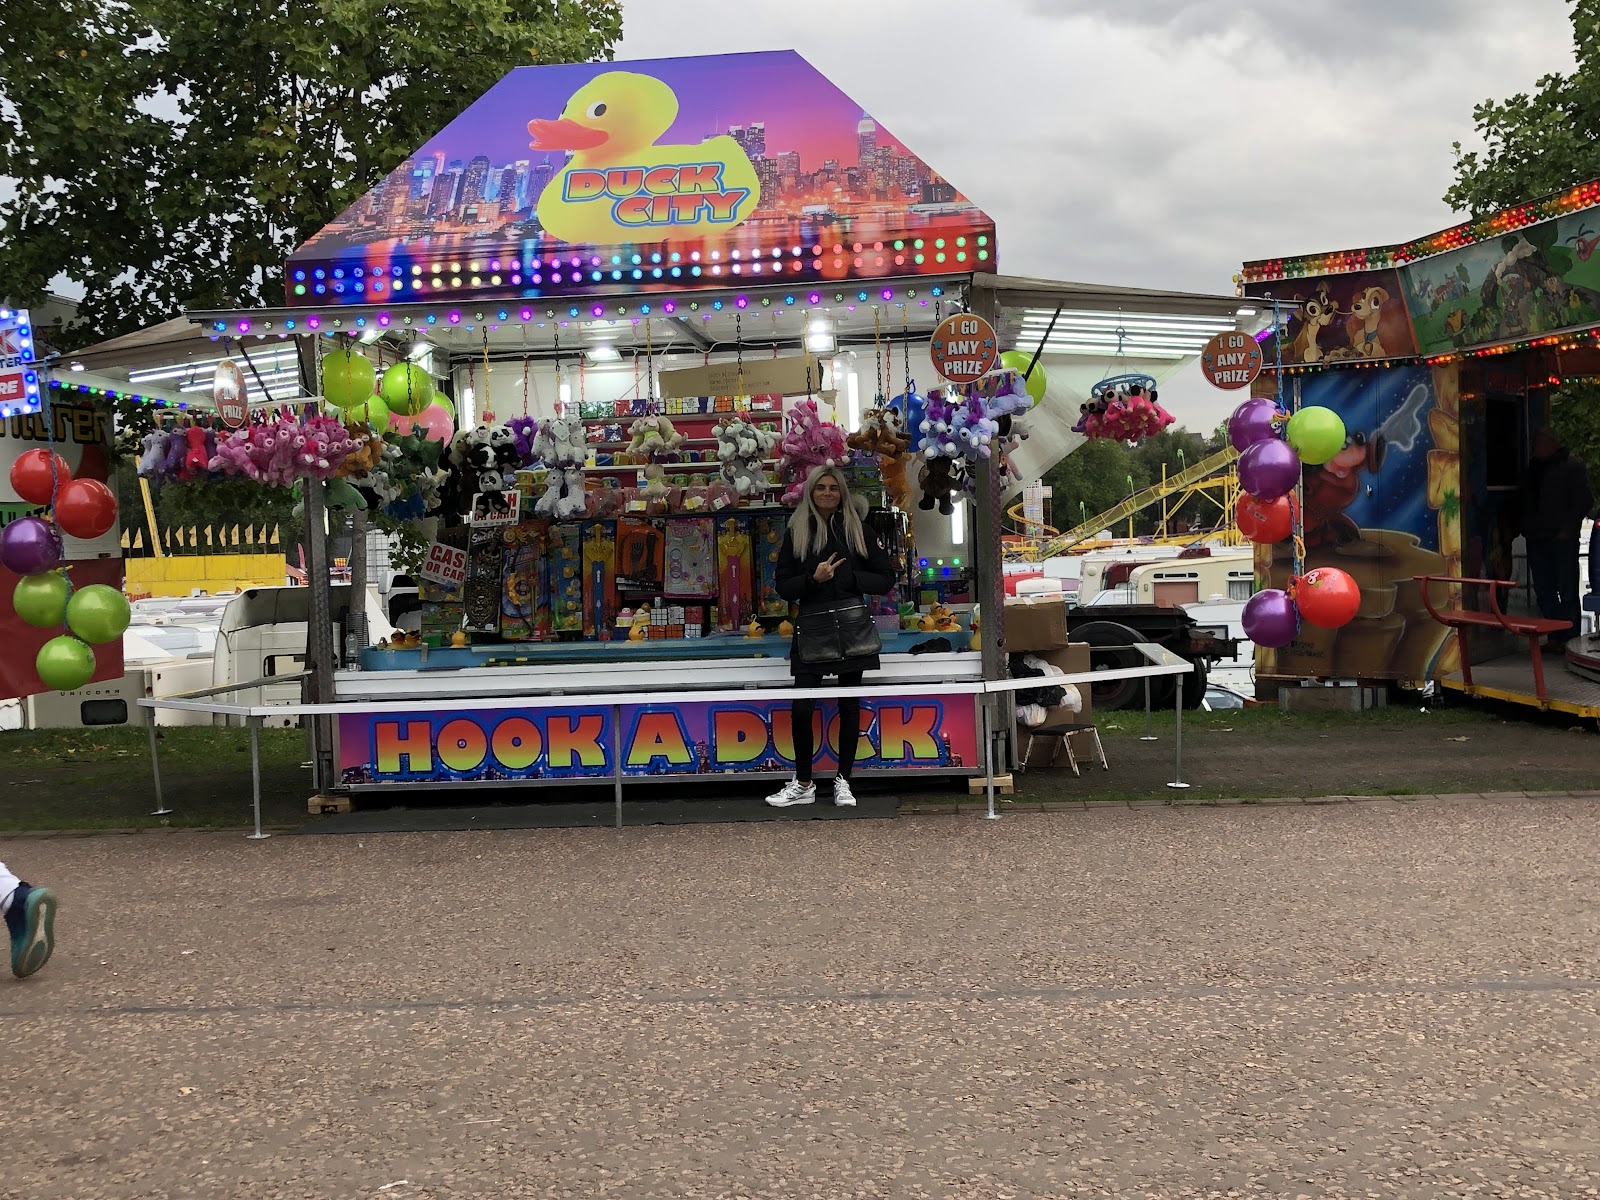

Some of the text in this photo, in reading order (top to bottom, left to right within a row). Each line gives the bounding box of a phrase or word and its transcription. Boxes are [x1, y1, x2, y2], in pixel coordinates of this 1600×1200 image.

[566, 163, 722, 199] DUCK
[614, 189, 748, 226] CITY
[948, 320, 978, 335] 1 GO
[947, 340, 980, 356] ANY
[1217, 335, 1244, 349] 1 GO
[1217, 352, 1247, 367] ANY
[943, 360, 983, 376] PRIZE
[1214, 370, 1249, 384] PRIZE
[222, 404, 243, 420] PRIZE
[430, 545, 466, 570] CAS
[425, 561, 440, 575] OR
[442, 566, 465, 582] CAR
[60, 689, 120, 697] UNICORN
[375, 706, 940, 773] HOOK A DUCK
